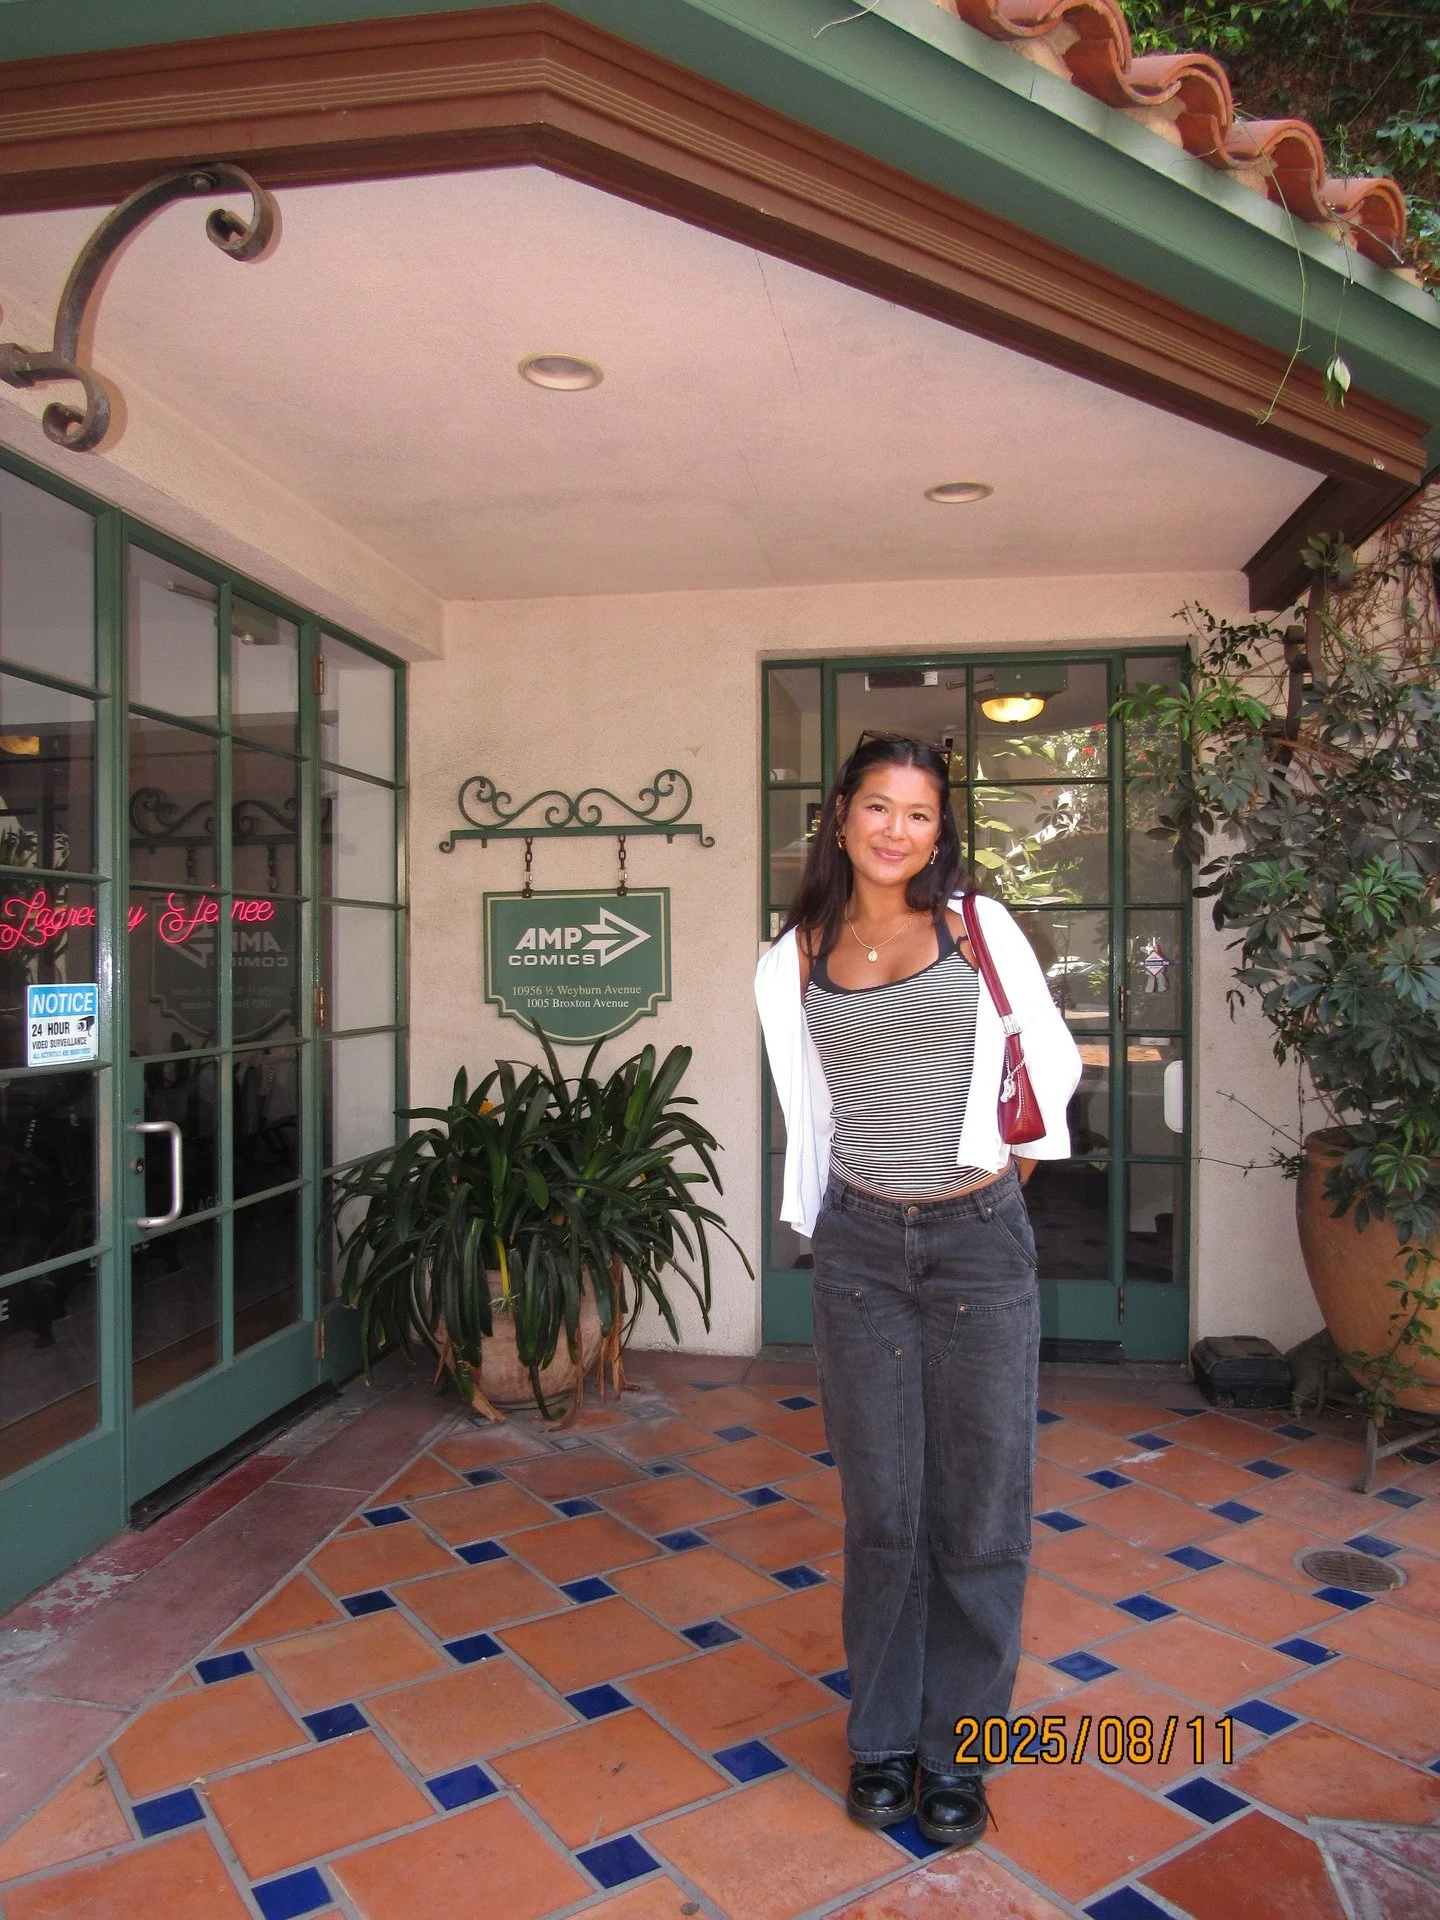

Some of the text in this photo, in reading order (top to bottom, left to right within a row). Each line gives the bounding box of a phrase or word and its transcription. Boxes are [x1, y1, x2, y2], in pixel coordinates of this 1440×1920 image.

[128, 906, 148, 933] y
[515, 927, 583, 950] AMP
[508, 954, 596, 966] COMICS
[512, 986, 542, 996] 10956
[557, 986, 602, 998] Weyburn
[604, 985, 642, 995] Avenue
[32, 992, 94, 1014] NOTICE
[526, 999, 629, 1008] 1005 Broxton Avenue
[32, 1022, 70, 1037] 24 HOUR
[32, 1037, 87, 1050] VIDEO SURVEILLANCE
